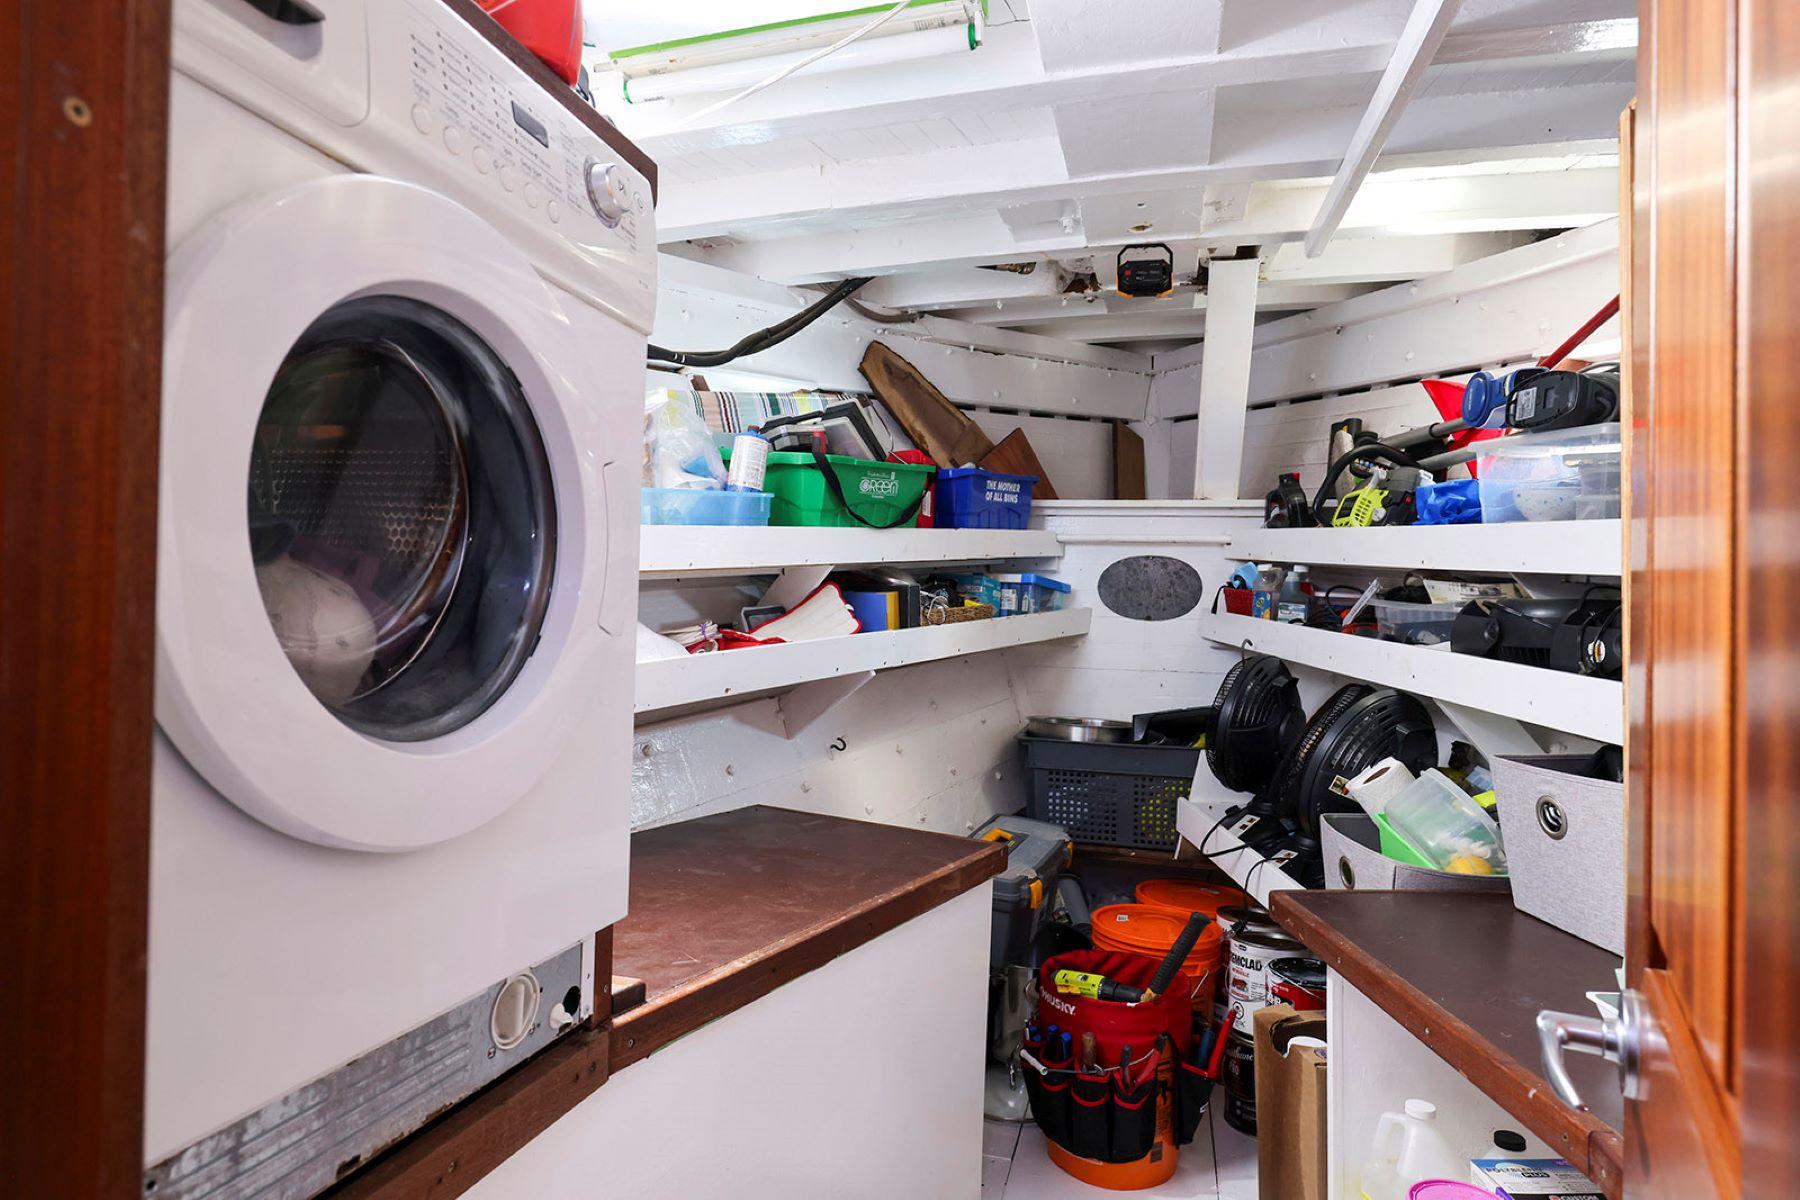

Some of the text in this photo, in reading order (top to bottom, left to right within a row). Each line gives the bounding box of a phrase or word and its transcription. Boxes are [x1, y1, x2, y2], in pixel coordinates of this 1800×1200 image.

[986, 480, 1020, 492] THE MOTHER
[985, 491, 1018, 503] OF ALL BINS
